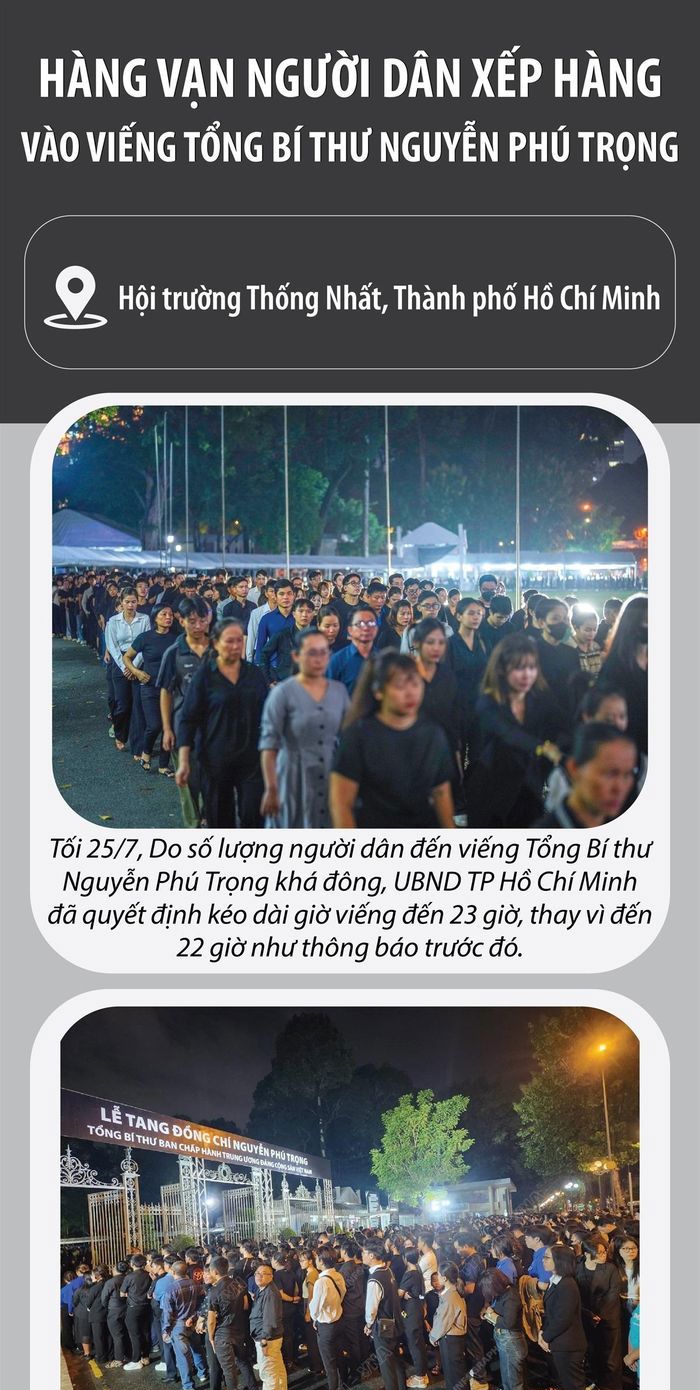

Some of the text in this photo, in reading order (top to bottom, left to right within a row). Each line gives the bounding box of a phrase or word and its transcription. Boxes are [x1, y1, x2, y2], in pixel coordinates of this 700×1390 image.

[87, 1125, 121, 1140] TỔNG
[124, 1132, 135, 1142] BÍ
[136, 1134, 157, 1146] THƯ
[159, 1139, 177, 1150] BAN
[222, 1151, 243, 1162] TRUNG
[100, 1105, 122, 1125] LỄ
[125, 1113, 169, 1135] TANG
[213, 1135, 231, 1149] CHÍ
[271, 1149, 286, 1160] PHÚ
[286, 1153, 308, 1166] TRỌNG
